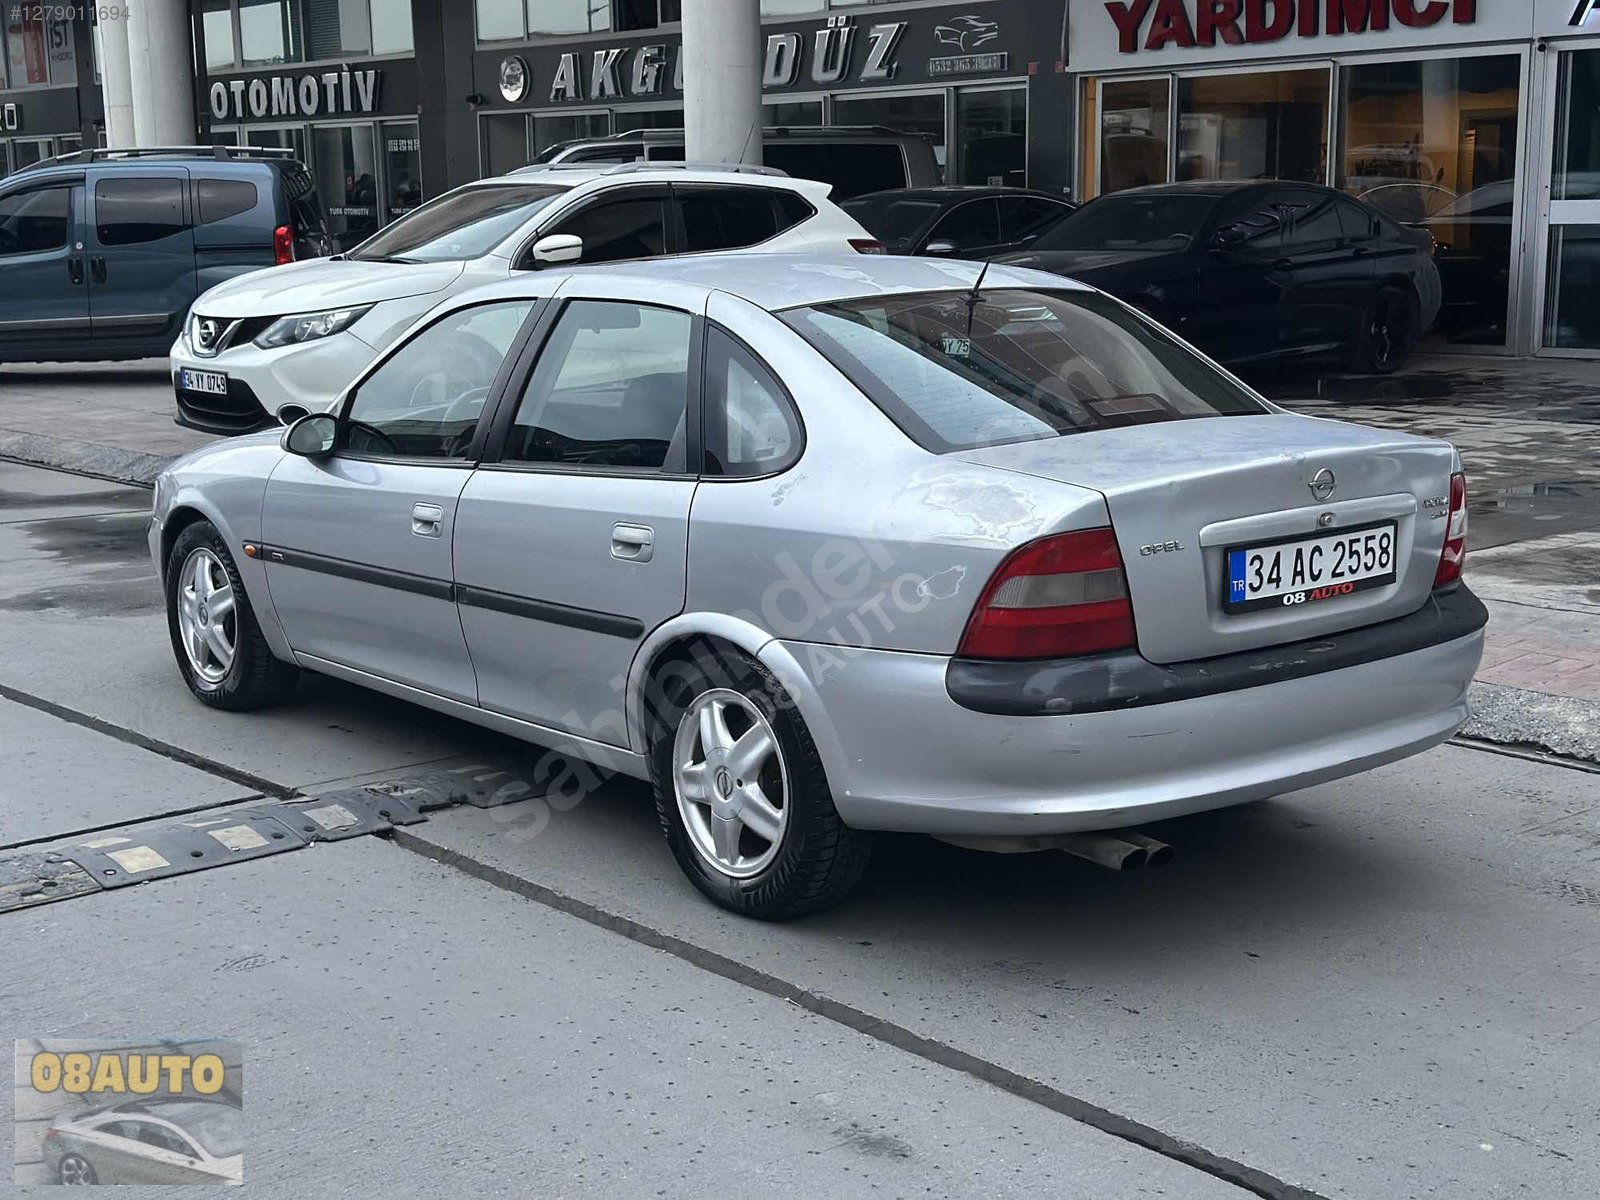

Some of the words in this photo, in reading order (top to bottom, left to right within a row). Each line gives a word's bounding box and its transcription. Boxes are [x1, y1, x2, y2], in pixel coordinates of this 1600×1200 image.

[551, 16, 907, 102] AKGDÜZ
[210, 64, 380, 119] OTOMOTİV
[1139, 540, 1185, 556] OPEL
[1248, 551, 1282, 593] 34
[1291, 545, 1323, 586] AC
[1331, 532, 1391, 579] 2558
[1232, 580, 1245, 592] TR
[1282, 592, 1306, 606] 08
[1309, 582, 1355, 601] AUTO
